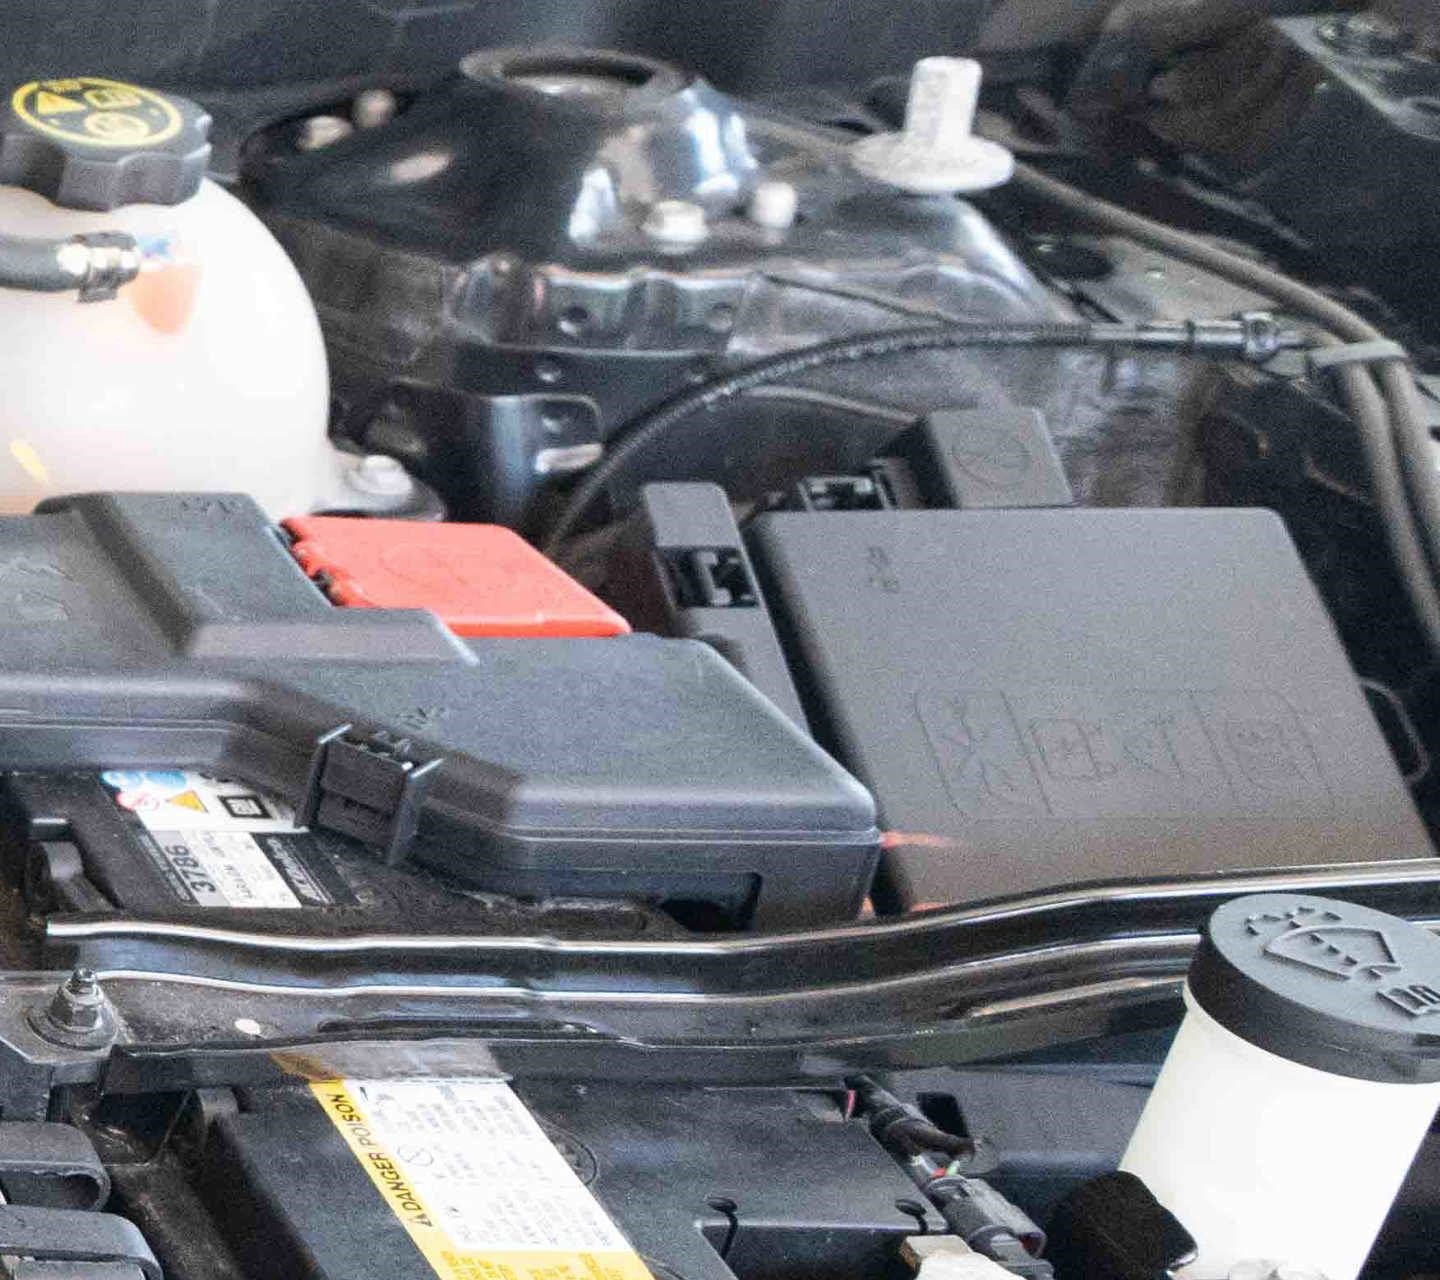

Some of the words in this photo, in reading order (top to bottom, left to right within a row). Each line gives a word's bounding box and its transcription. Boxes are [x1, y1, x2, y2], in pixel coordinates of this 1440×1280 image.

[165, 844, 218, 893] 3786
[327, 1093, 376, 1147] POISON
[368, 1152, 422, 1211] DANGER
